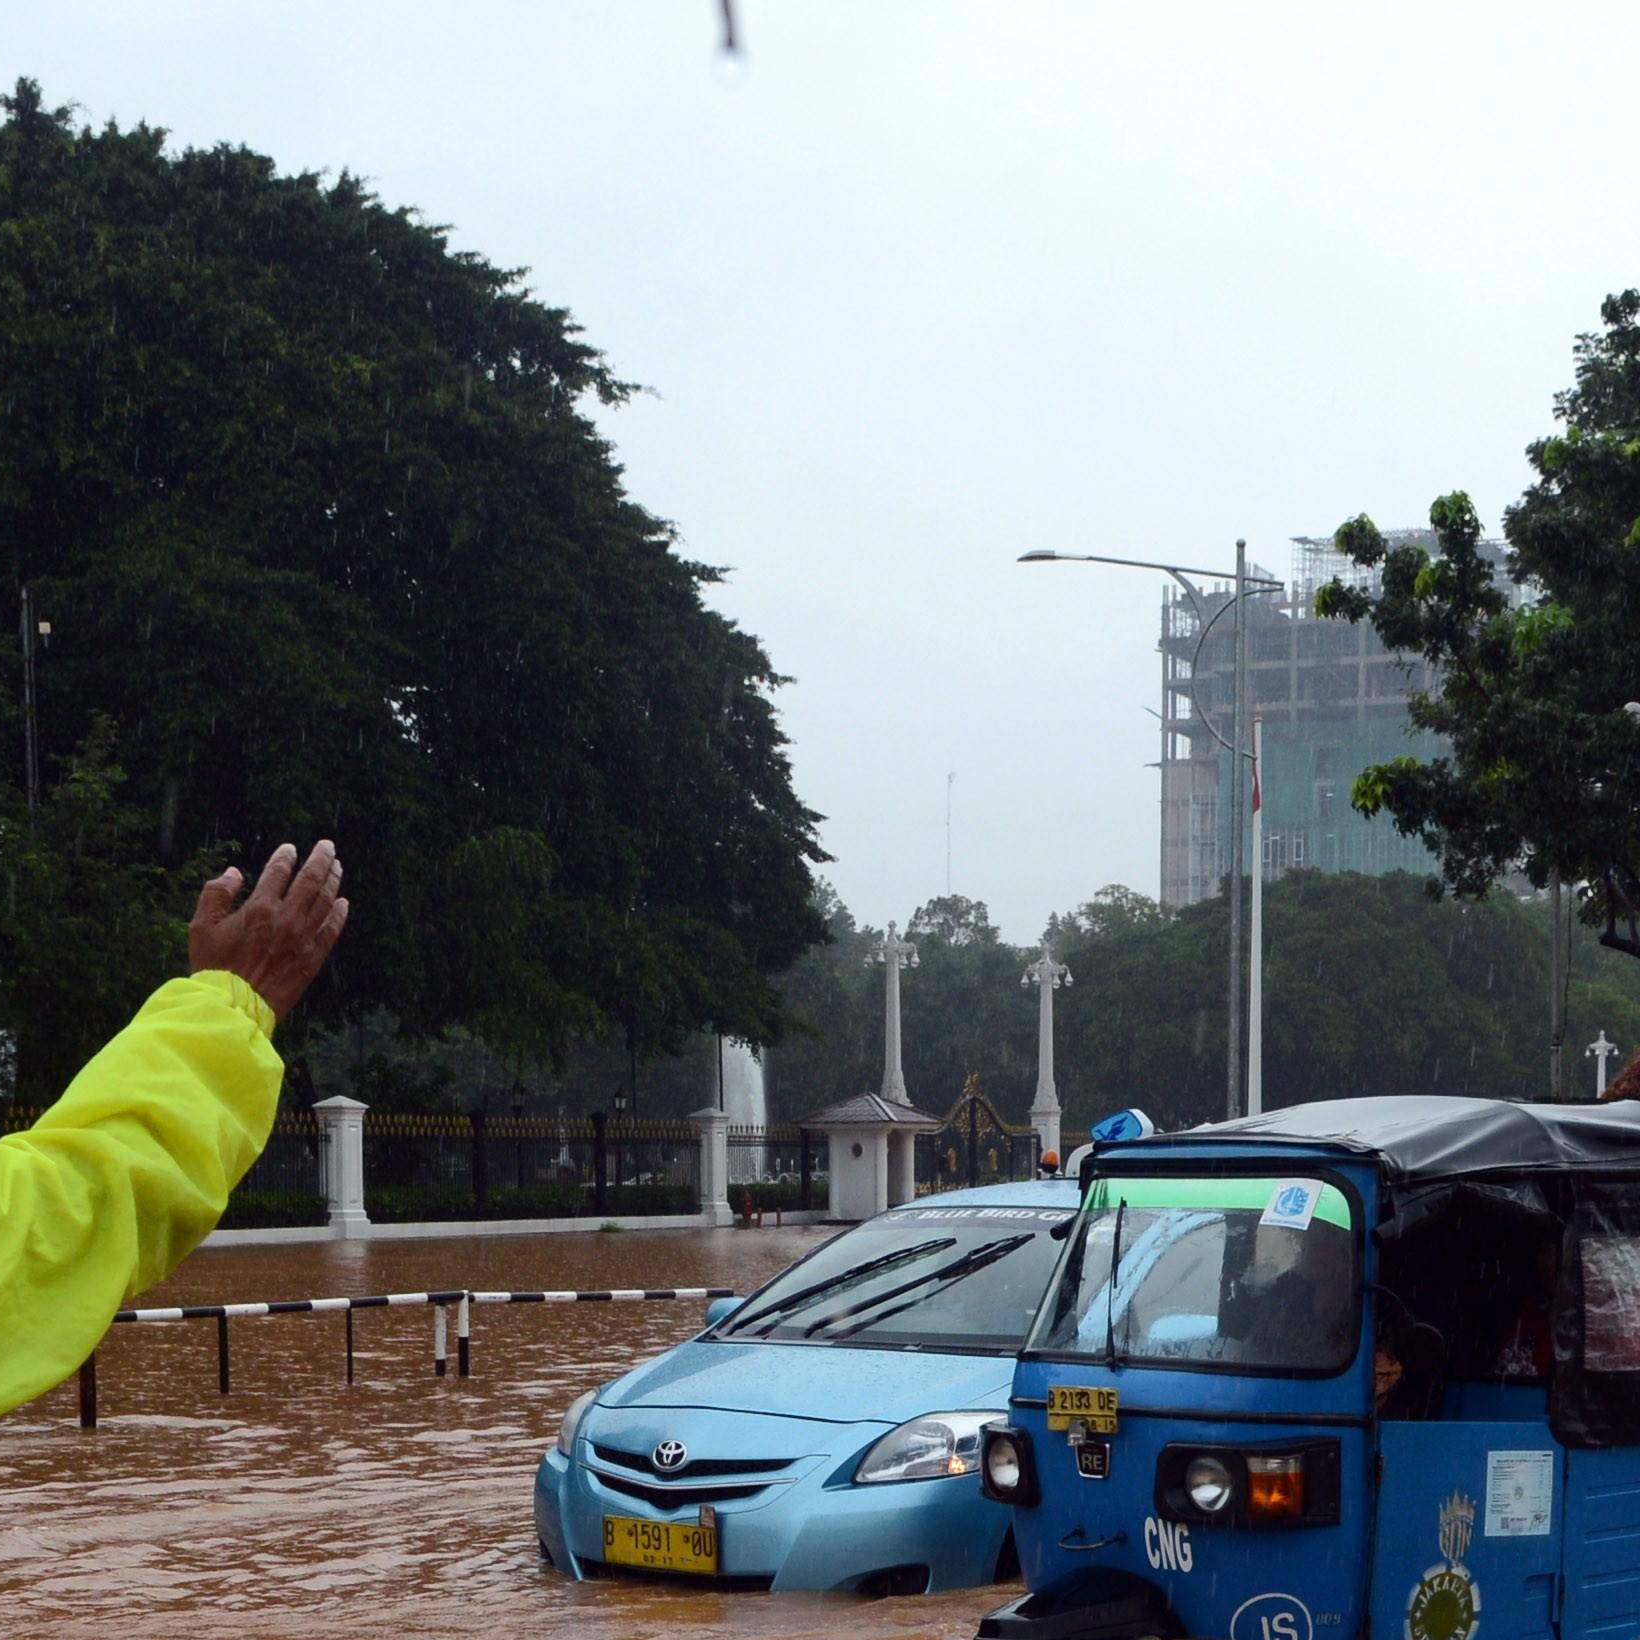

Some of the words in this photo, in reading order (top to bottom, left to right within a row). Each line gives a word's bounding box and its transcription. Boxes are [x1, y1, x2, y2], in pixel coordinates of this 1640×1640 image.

[917, 1208, 977, 1220] BLUE
[975, 1208, 1036, 1220] BIRD
[1048, 1389, 1056, 1410] B
[1060, 1390, 1091, 1410] 2133
[1081, 1454, 1104, 1470] RE
[605, 1520, 615, 1546] B
[633, 1523, 671, 1553] 1591
[1144, 1516, 1193, 1573] CNG
[1418, 1575, 1469, 1608] JAKARTA
